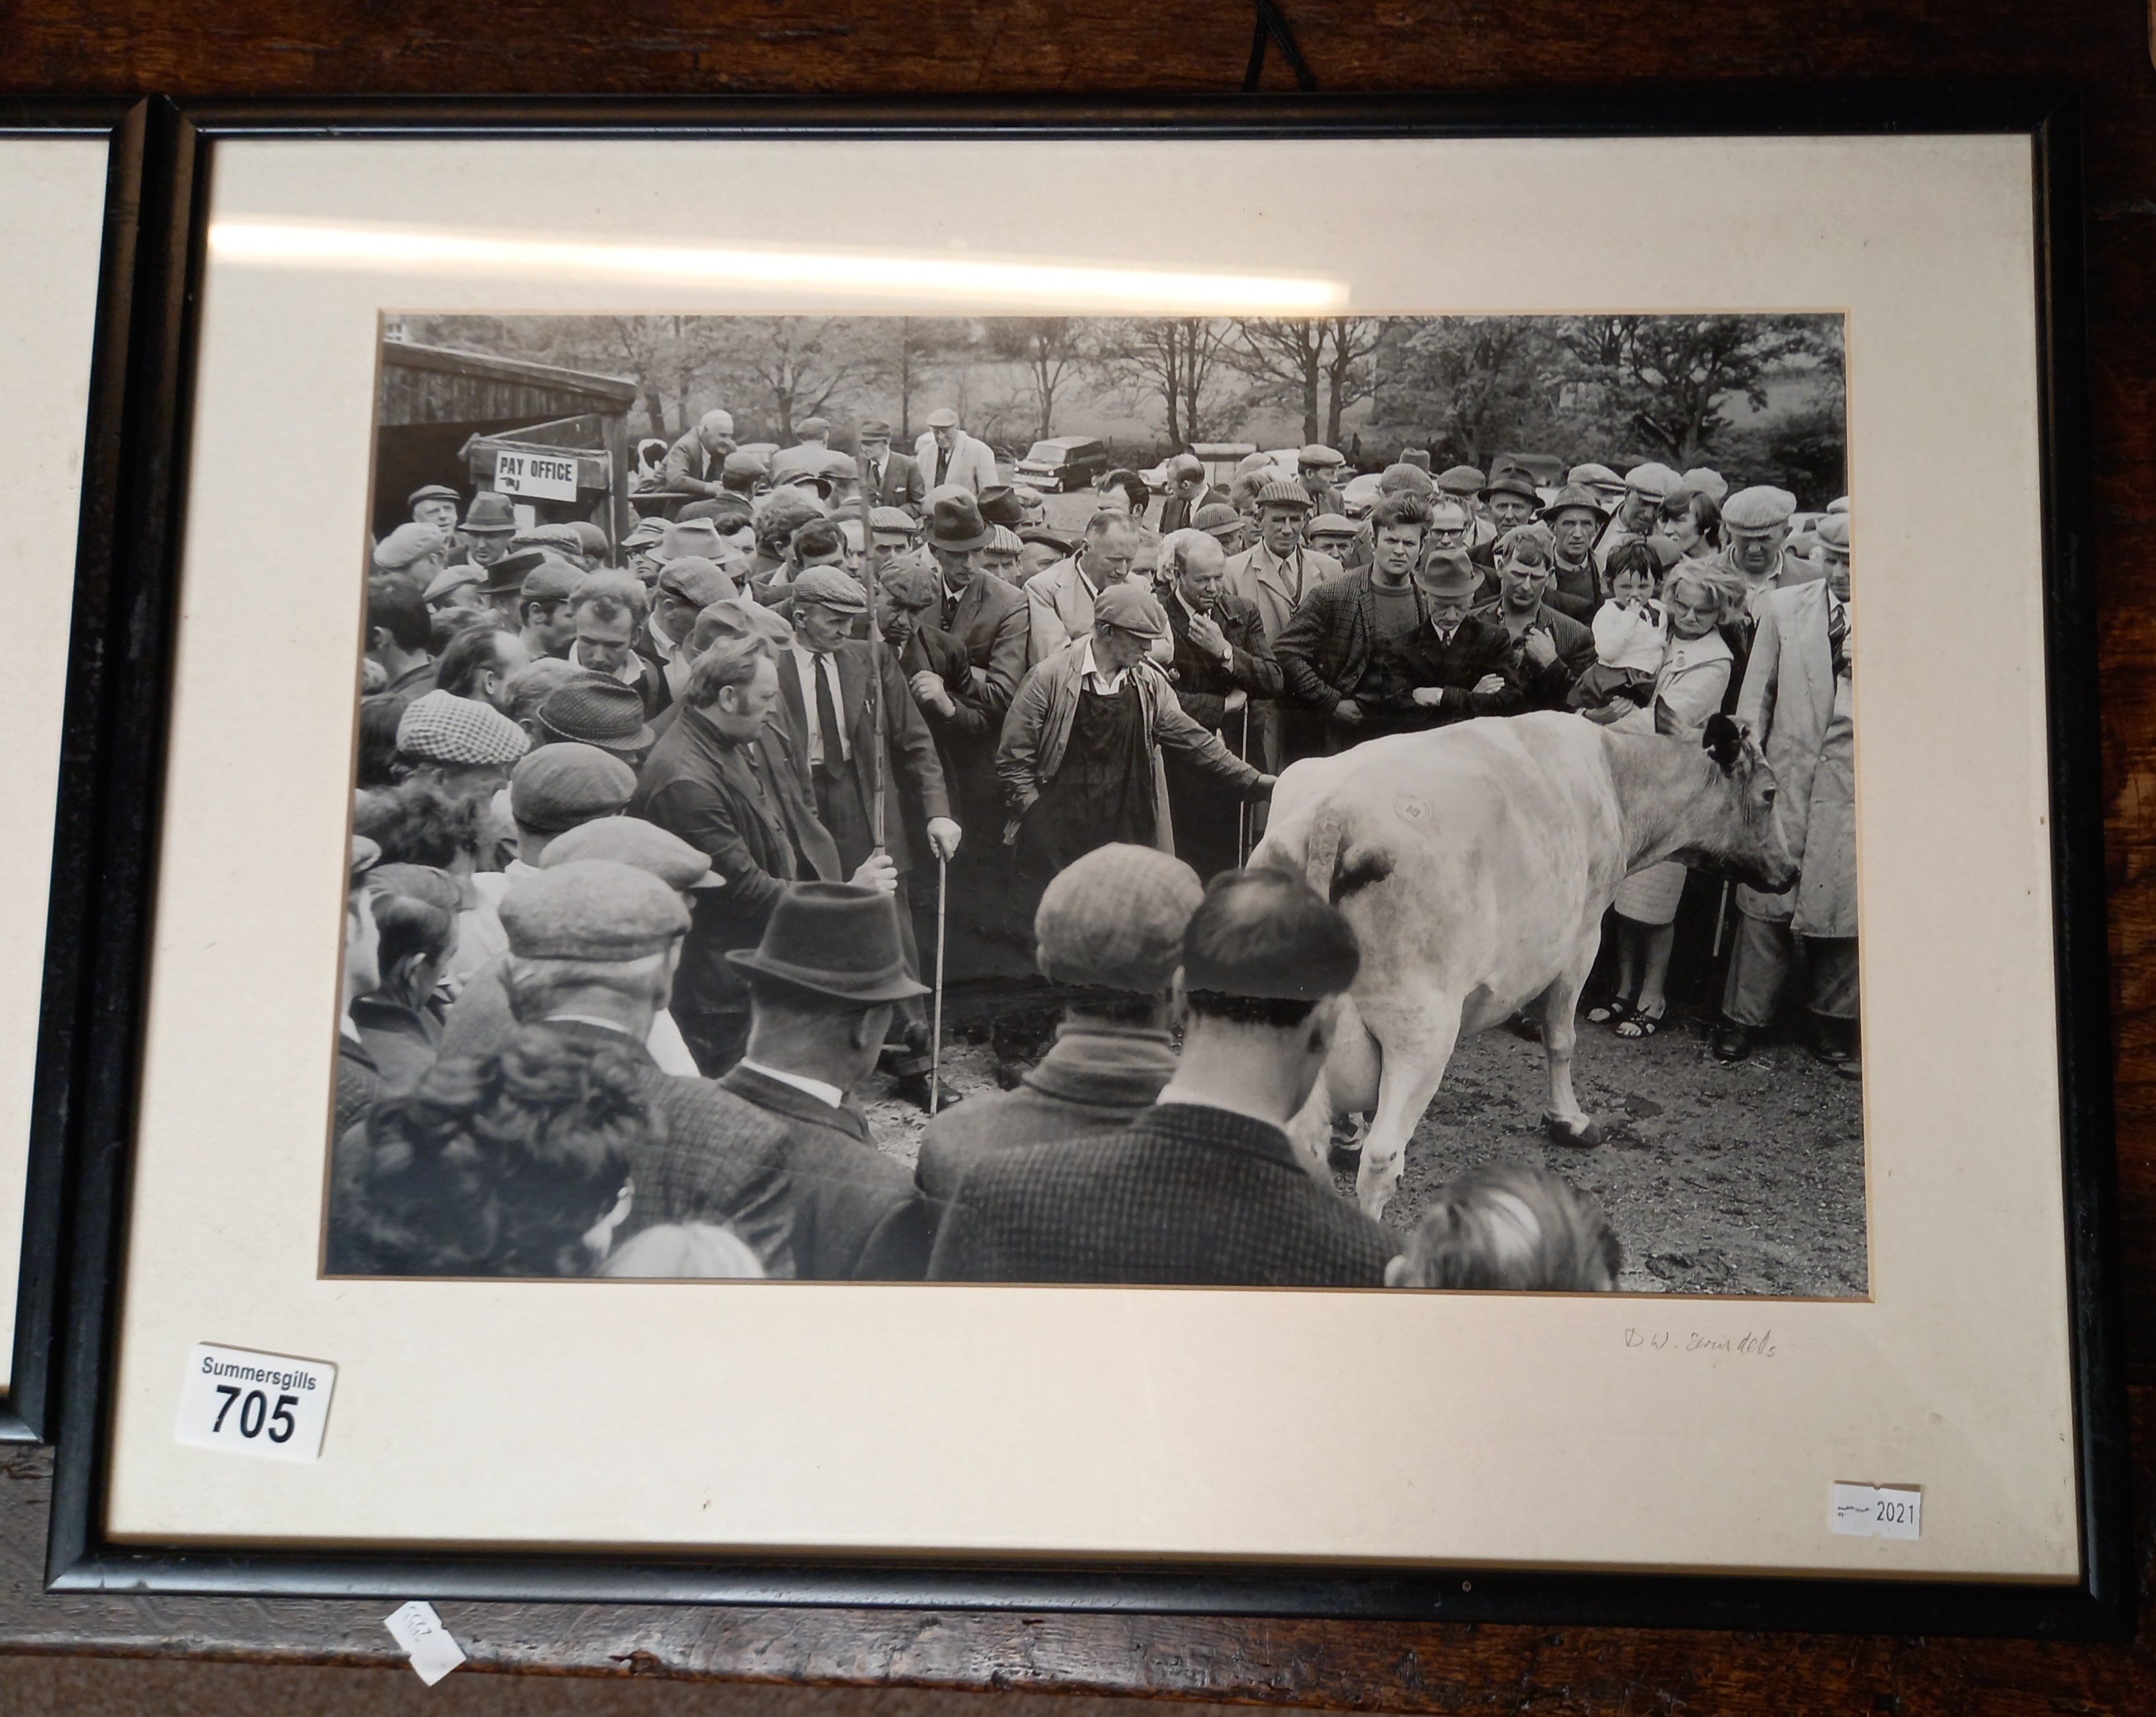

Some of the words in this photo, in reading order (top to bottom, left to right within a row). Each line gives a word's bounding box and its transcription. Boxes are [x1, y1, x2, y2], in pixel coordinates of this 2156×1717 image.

[500, 457, 524, 475] PAY
[530, 460, 572, 482] OFFICE
[202, 1356, 317, 1391] Summersgills
[213, 1384, 300, 1444] 705
[1877, 1500, 1914, 1524] 2021
